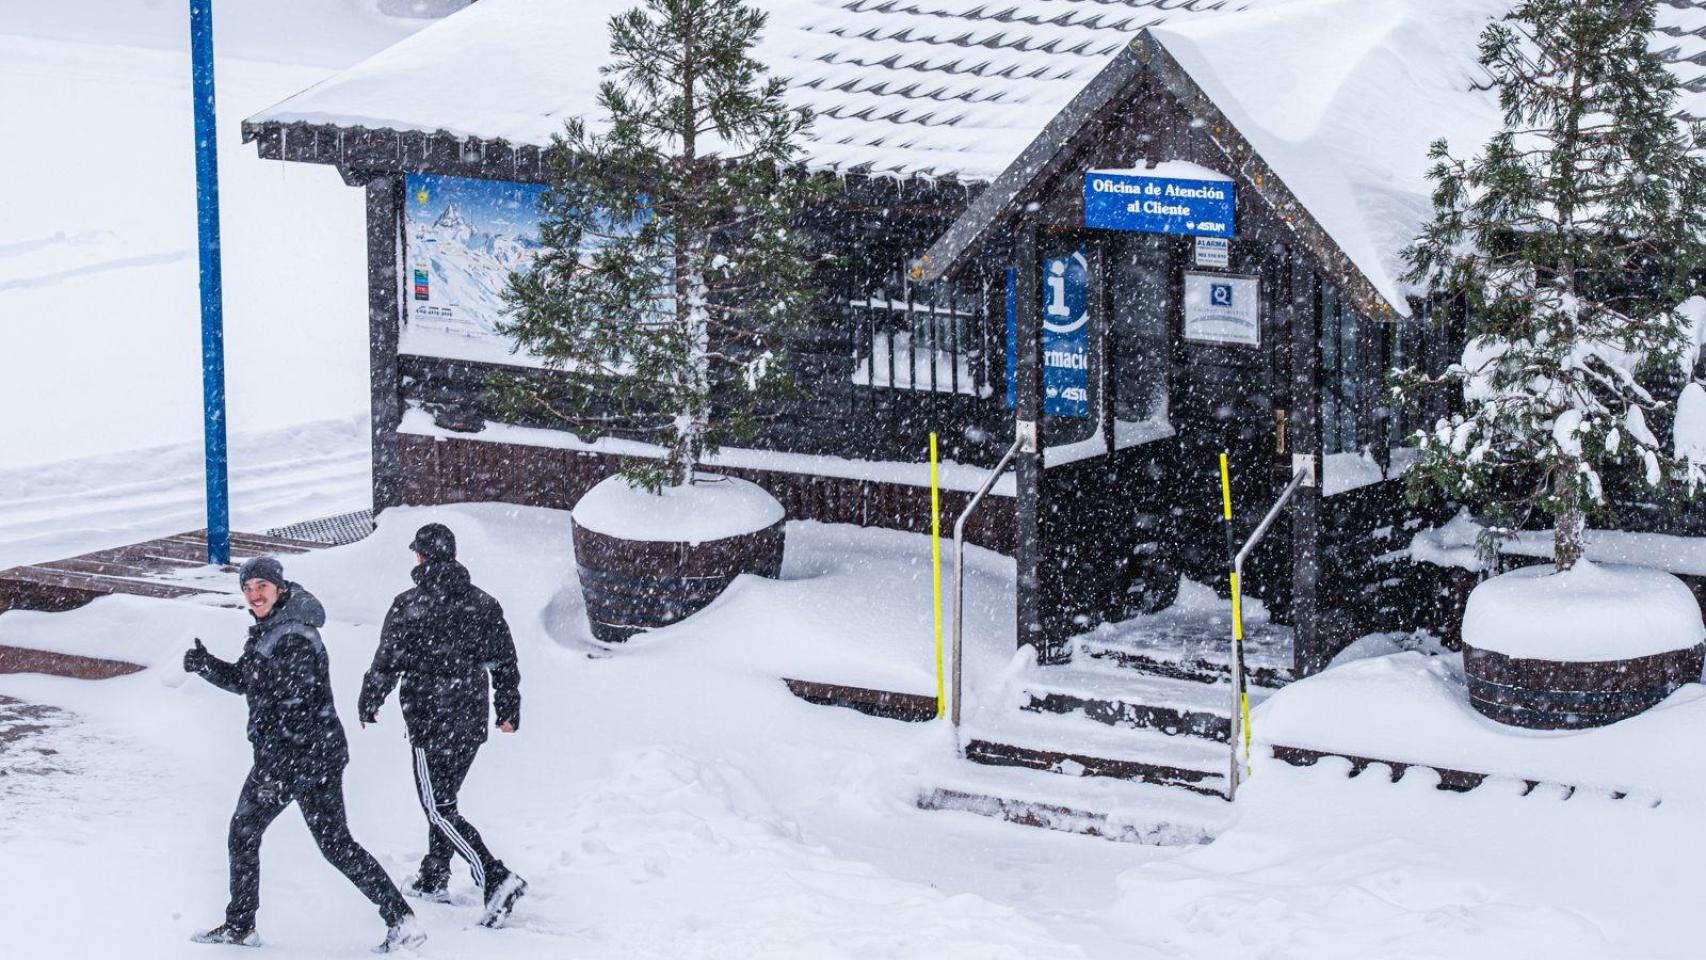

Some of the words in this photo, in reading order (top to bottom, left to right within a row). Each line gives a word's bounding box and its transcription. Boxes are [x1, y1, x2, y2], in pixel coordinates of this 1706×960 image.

[1093, 179, 1141, 195] Oficina
[1144, 182, 1161, 196] de
[1165, 183, 1225, 200] Atención
[1127, 200, 1140, 213] al
[1143, 200, 1191, 216] Cliente
